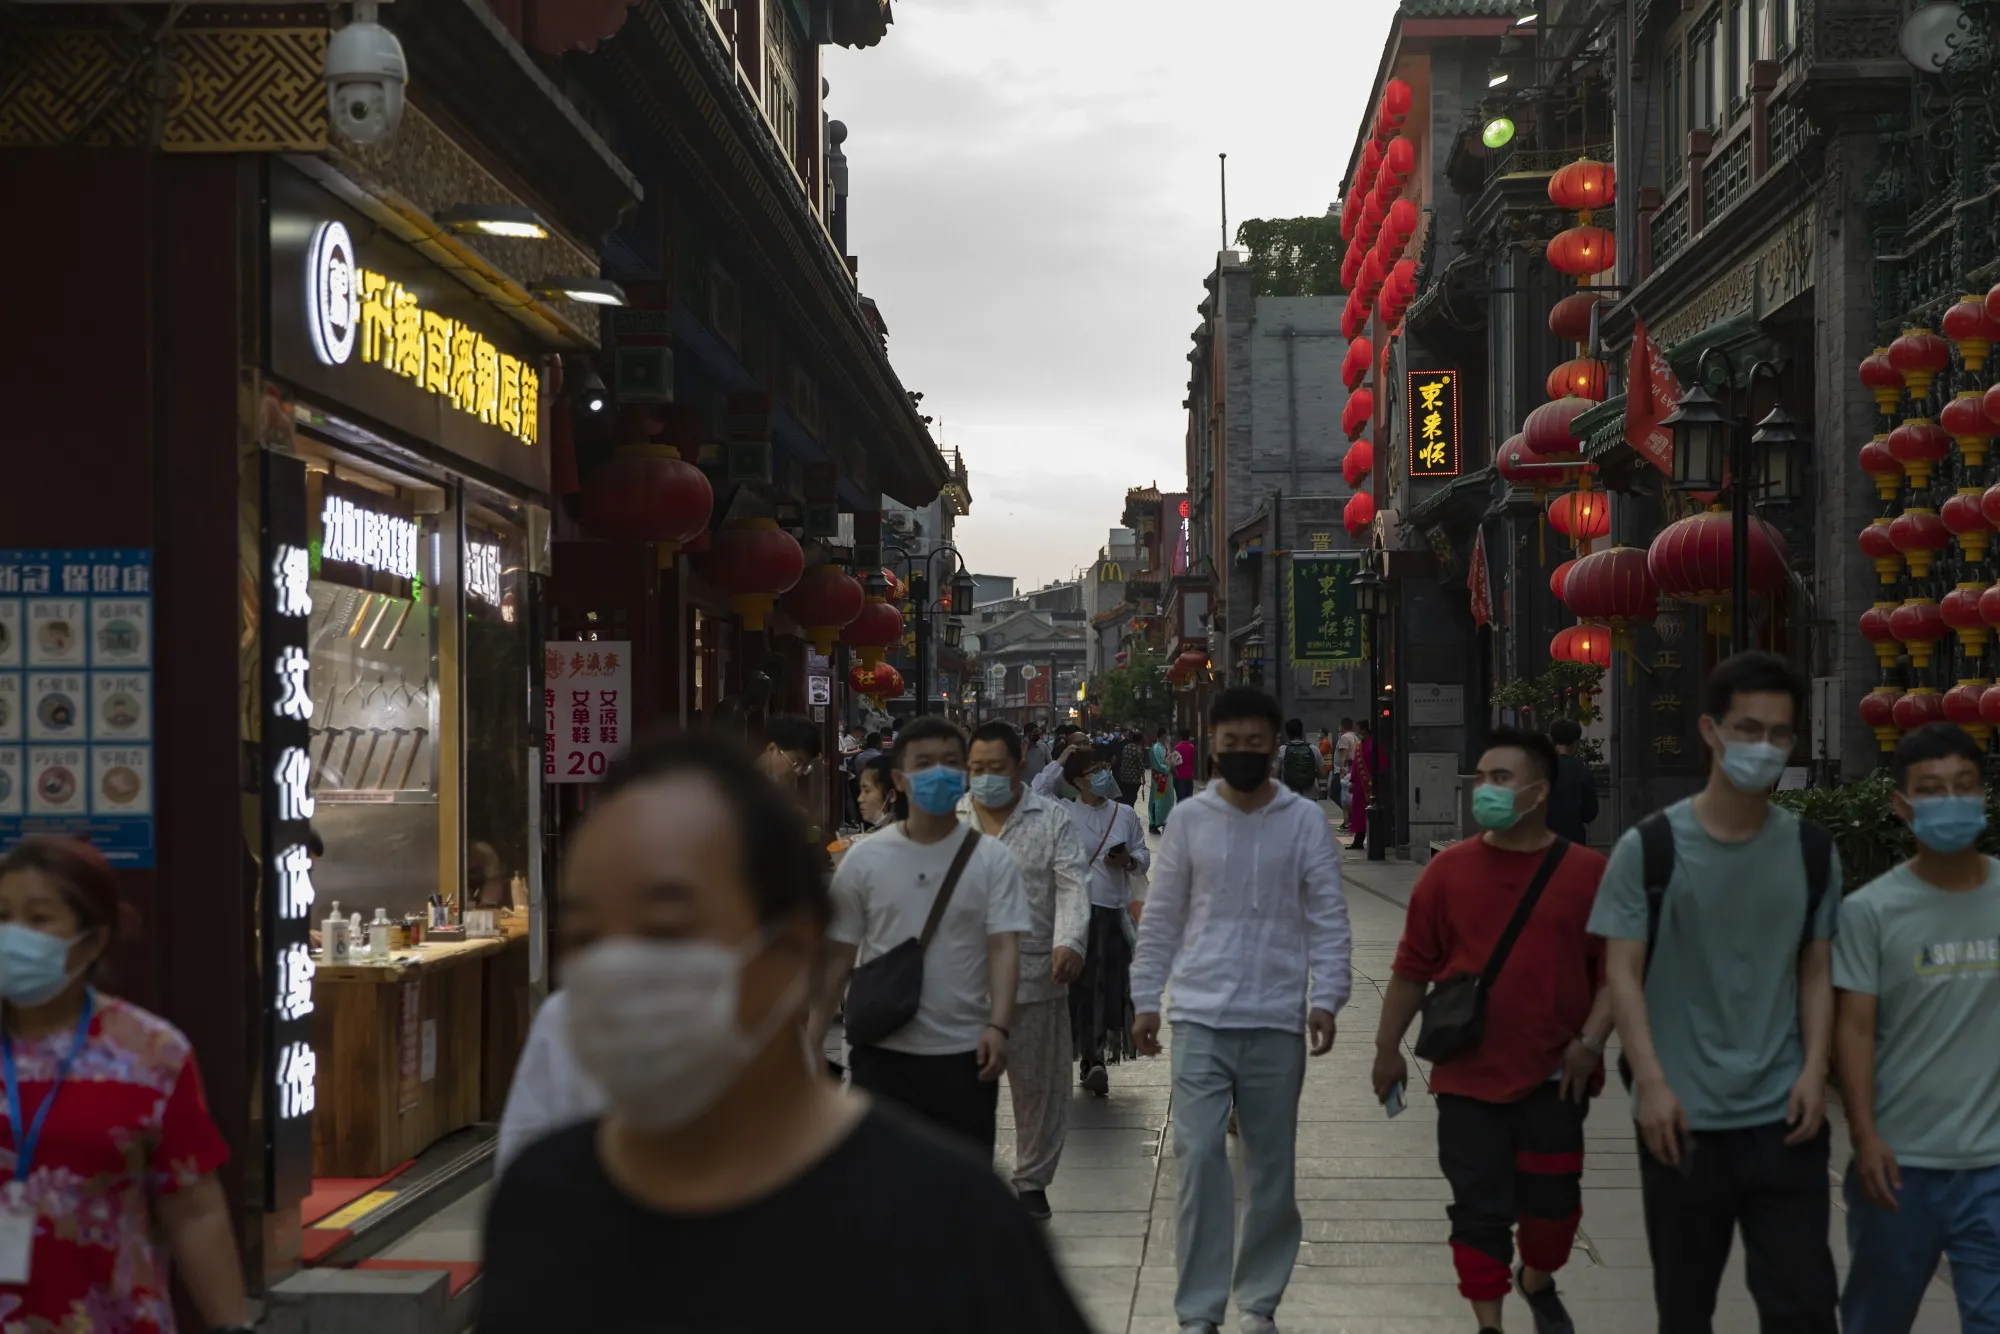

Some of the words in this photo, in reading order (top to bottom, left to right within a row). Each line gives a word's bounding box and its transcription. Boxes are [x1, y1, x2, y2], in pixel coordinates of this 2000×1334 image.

[62, 563, 149, 592] 保健康
[1311, 668, 1333, 688] 店
[572, 689, 590, 744] 女单鞋
[599, 689, 618, 744] 女凉鞋
[1651, 650, 1682, 756] 正兴德
[567, 750, 608, 776] 20
